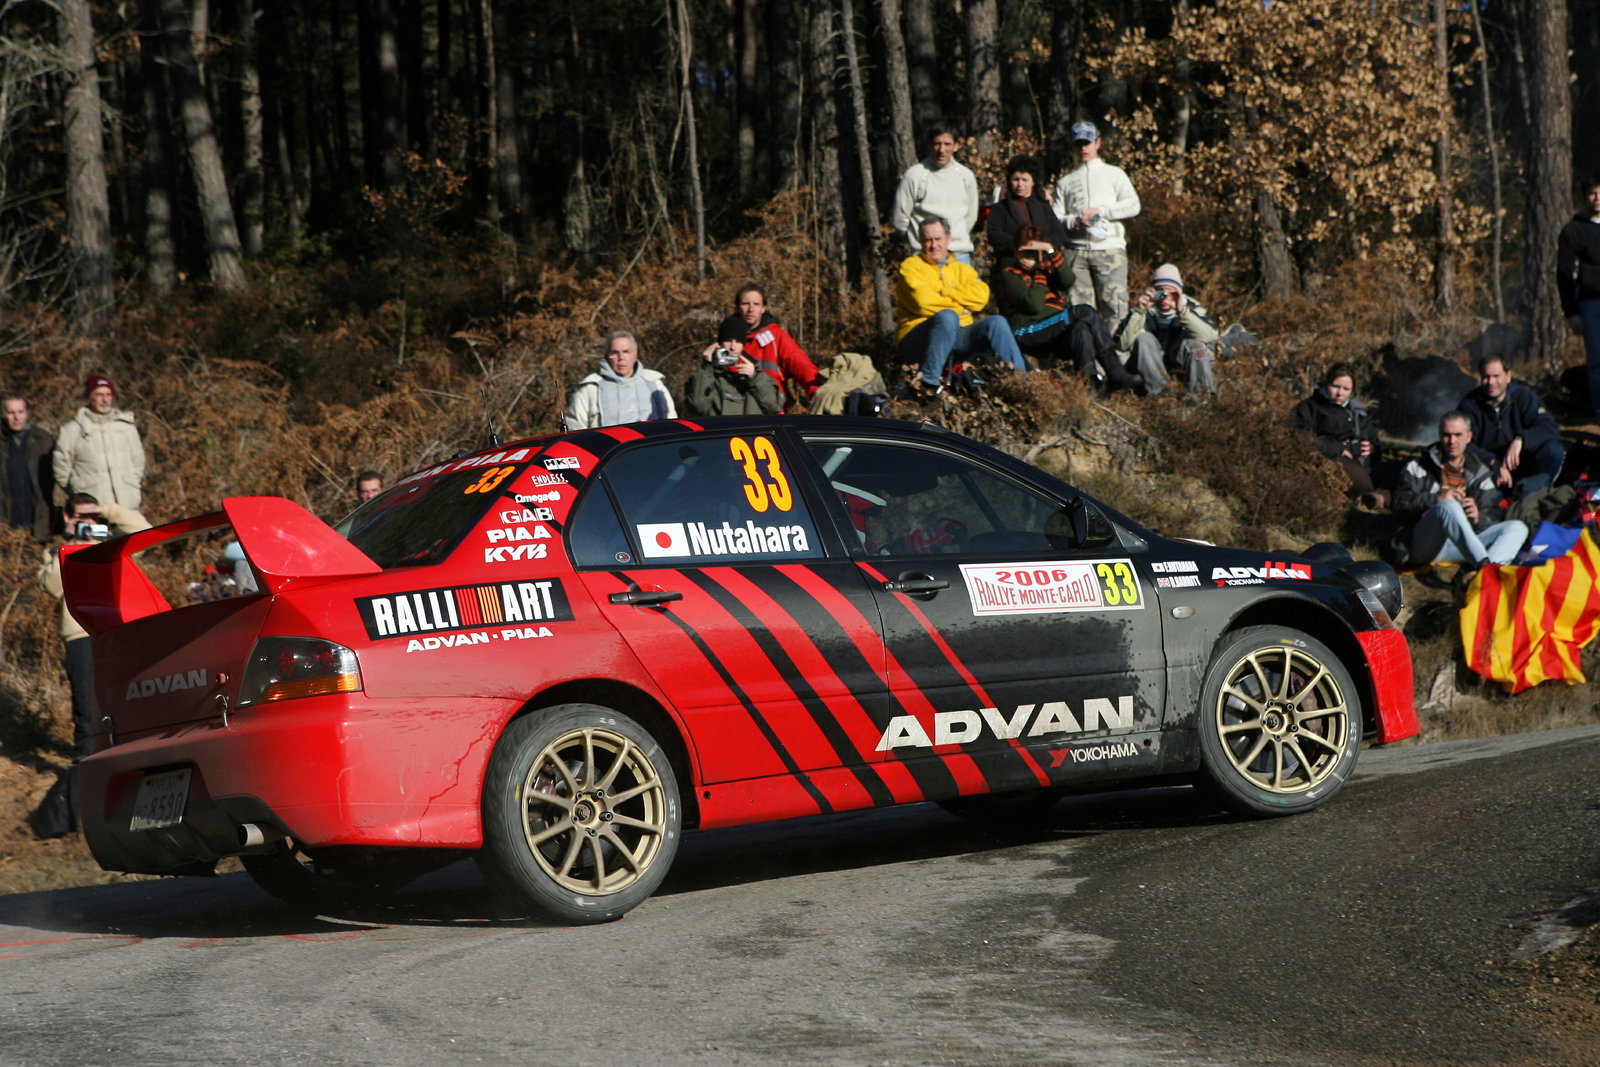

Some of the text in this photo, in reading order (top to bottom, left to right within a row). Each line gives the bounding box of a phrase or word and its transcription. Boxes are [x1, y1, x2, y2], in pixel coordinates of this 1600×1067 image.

[452, 449, 530, 471] PIAA
[545, 457, 579, 469] HKS
[463, 466, 516, 495] 33
[729, 436, 793, 512] 33
[500, 508, 554, 524] GAB
[486, 525, 552, 543] PIAA
[687, 520, 809, 556] Nutahara
[484, 543, 548, 563] KYB
[995, 562, 1138, 606] 2006 33
[1211, 567, 1309, 580] ADVAN
[1226, 578, 1266, 586] YOKOHAMA
[974, 577, 1016, 607] RALLYE
[371, 590, 460, 636] RALLI
[406, 626, 553, 653] ADVAN PIAA
[125, 668, 207, 701] ADVAN
[874, 695, 1134, 751] ADVAN
[1069, 742, 1139, 763] YOKOHAMA
